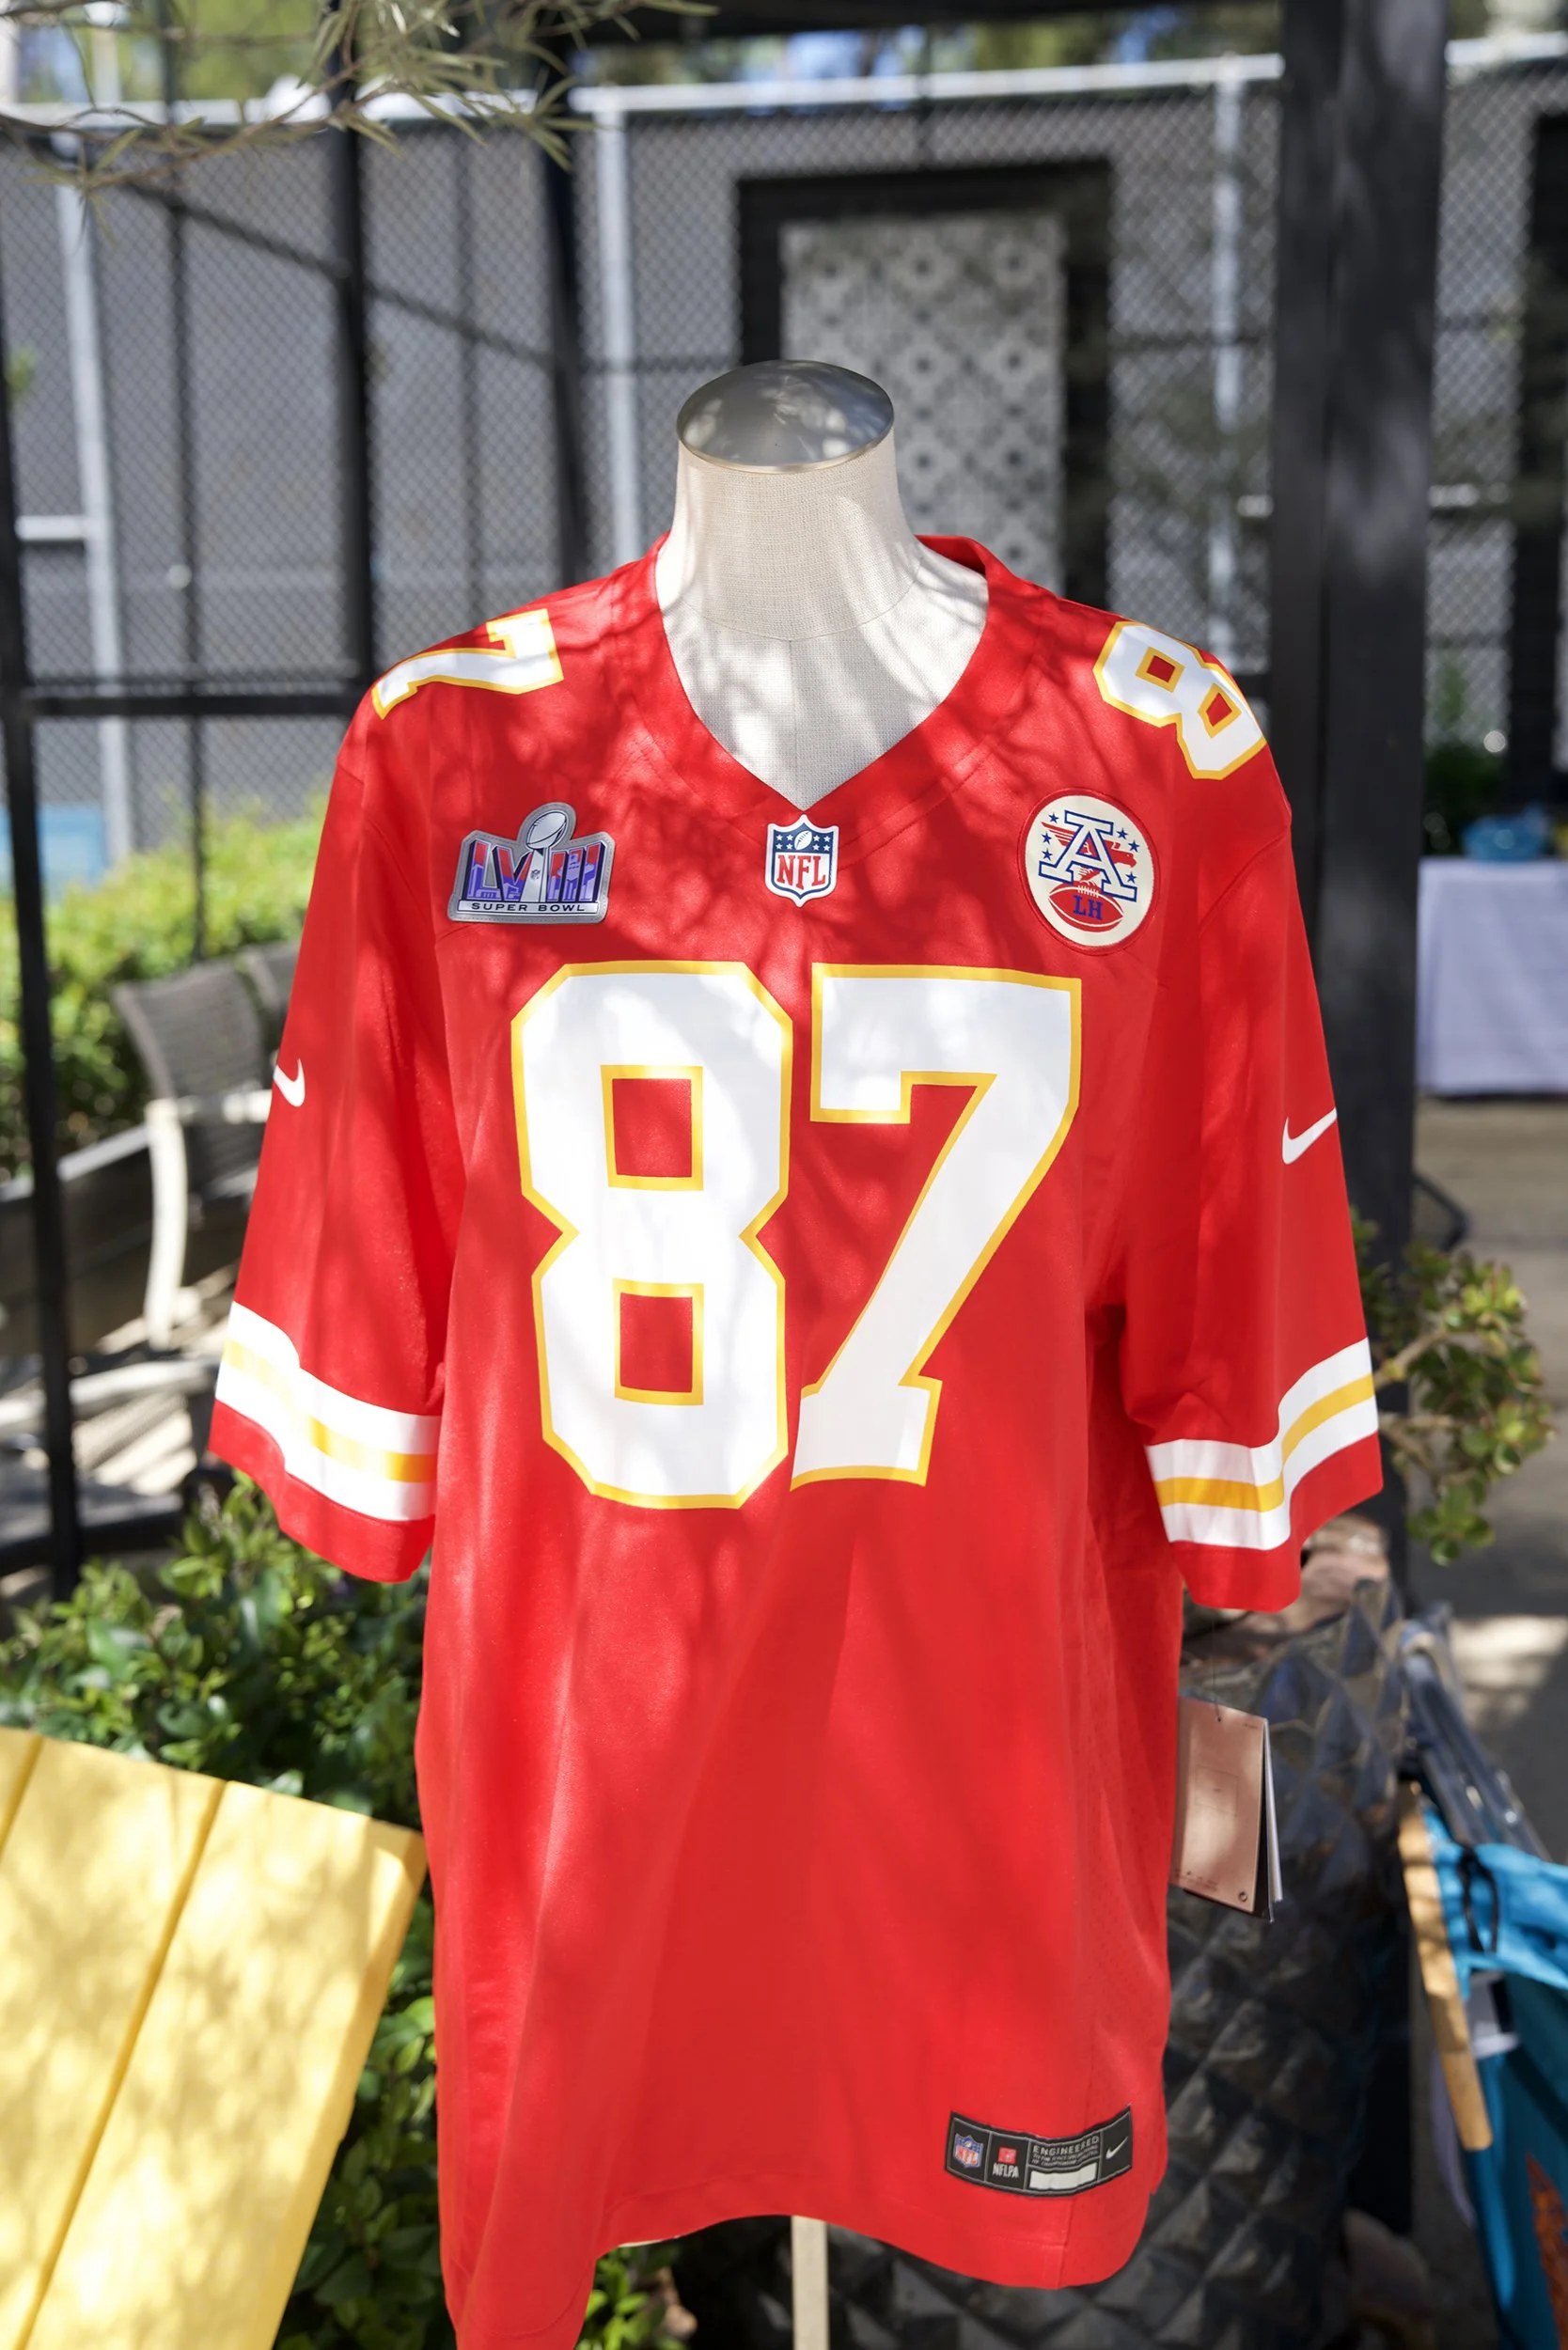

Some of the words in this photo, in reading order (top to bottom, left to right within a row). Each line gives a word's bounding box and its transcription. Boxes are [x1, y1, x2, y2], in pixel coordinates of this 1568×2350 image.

[776, 854, 826, 890] NFL
[471, 902, 528, 912] SUPER
[538, 904, 585, 913] BOWL
[1073, 895, 1103, 920] LH
[510, 960, 1082, 1509] 87
[1032, 2136, 1100, 2156] ENGINEERED
[992, 2162, 1020, 2179] NFLPA
